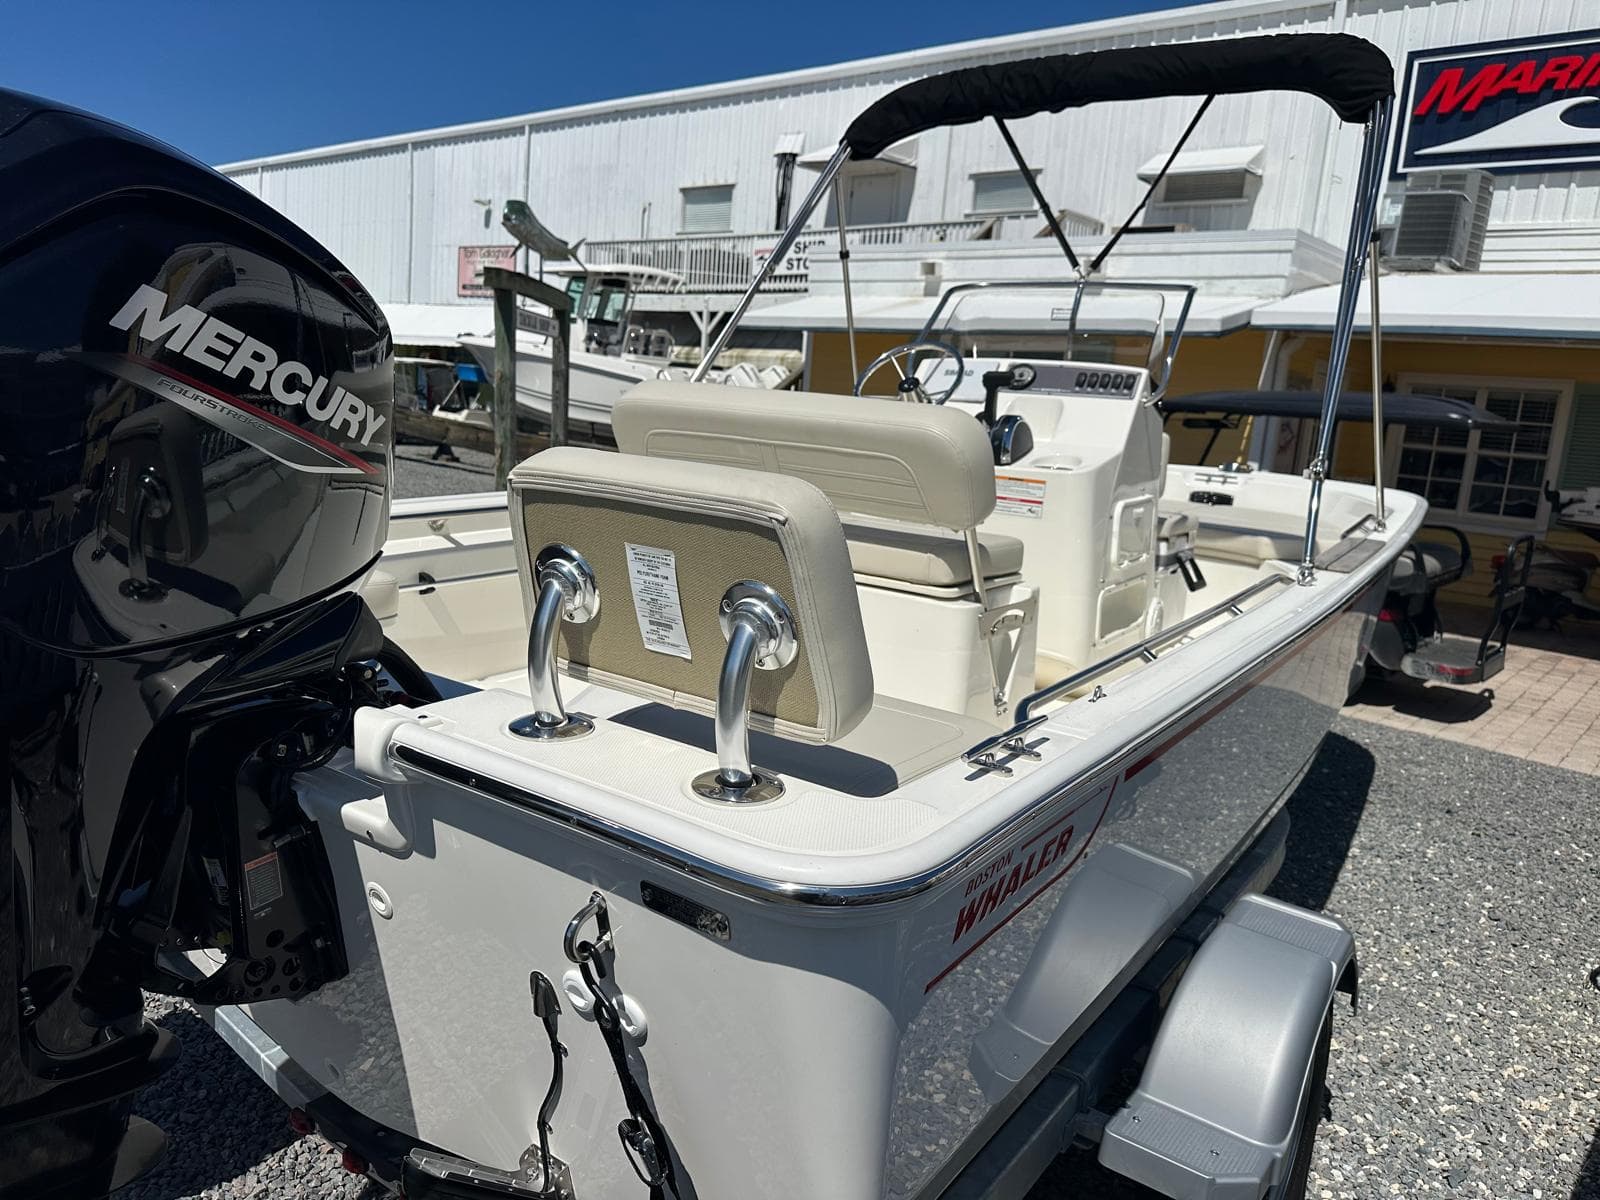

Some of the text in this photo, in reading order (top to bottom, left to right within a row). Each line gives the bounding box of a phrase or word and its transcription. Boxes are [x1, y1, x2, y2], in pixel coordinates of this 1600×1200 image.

[109, 283, 386, 447] MERCURY
[156, 377, 266, 433] FOURSTROKE
[952, 825, 1074, 945] WHALER
[965, 850, 1014, 897] BOSTON
